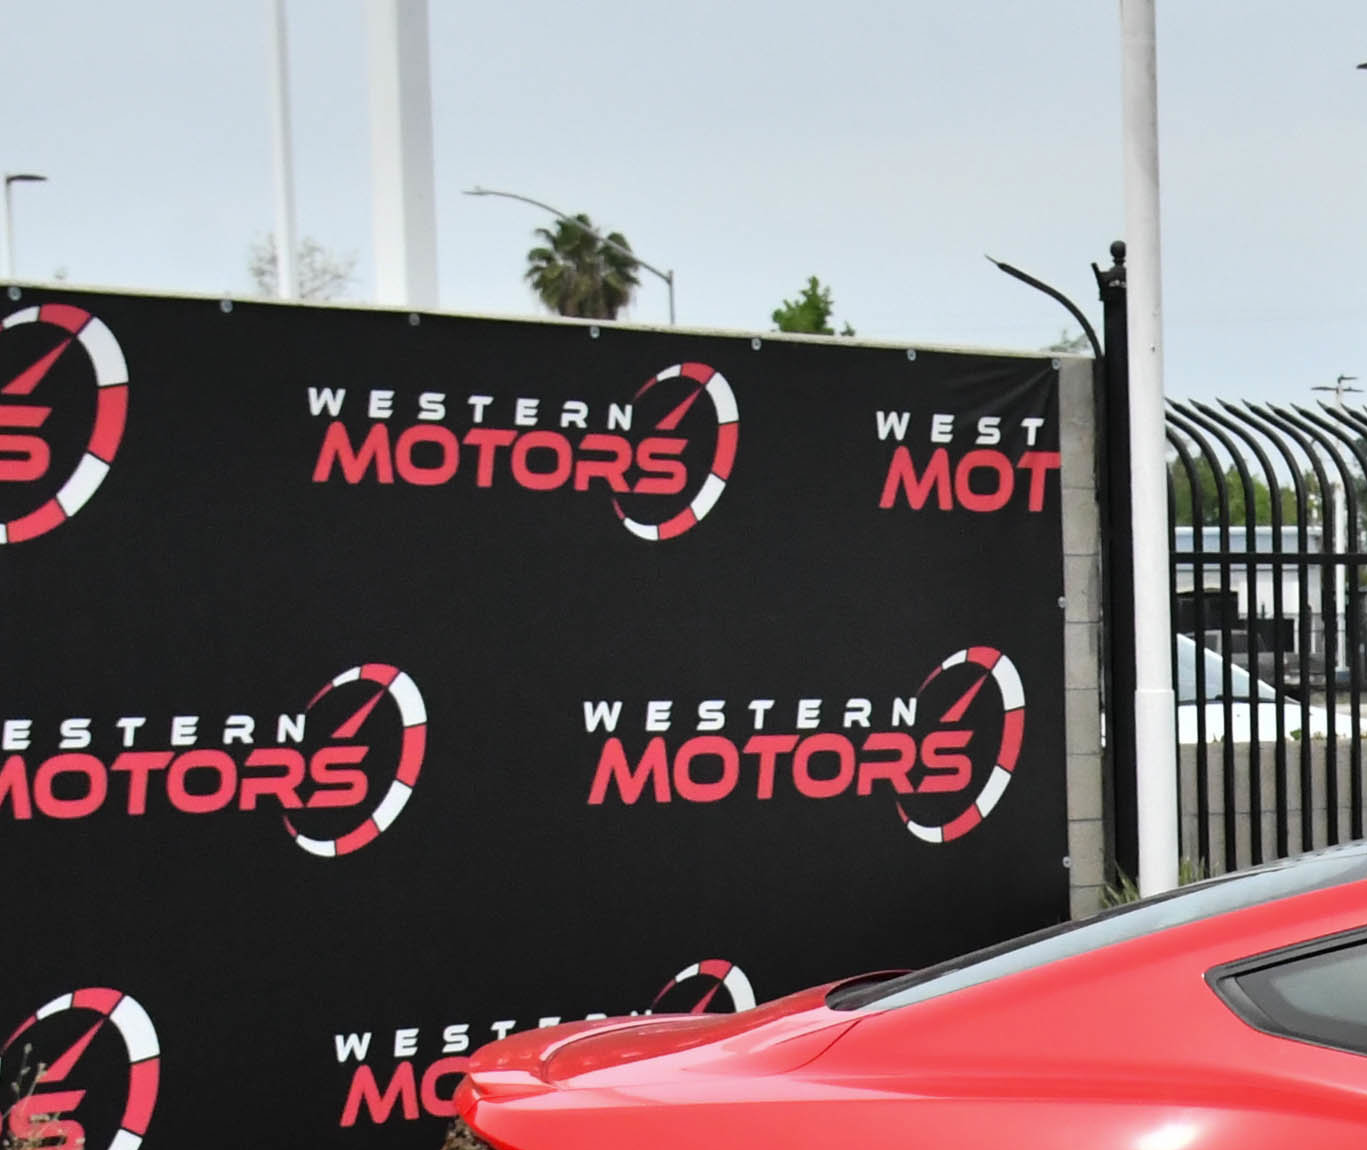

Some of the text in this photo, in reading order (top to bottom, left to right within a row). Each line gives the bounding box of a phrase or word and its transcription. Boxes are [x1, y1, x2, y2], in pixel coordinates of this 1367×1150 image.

[309, 388, 632, 430] WESTERN
[877, 411, 1043, 445] WEST
[313, 420, 687, 494] MOTORS
[880, 446, 1061, 512] MOT
[584, 698, 916, 732] WESTERN
[588, 731, 974, 805] MOTORS
